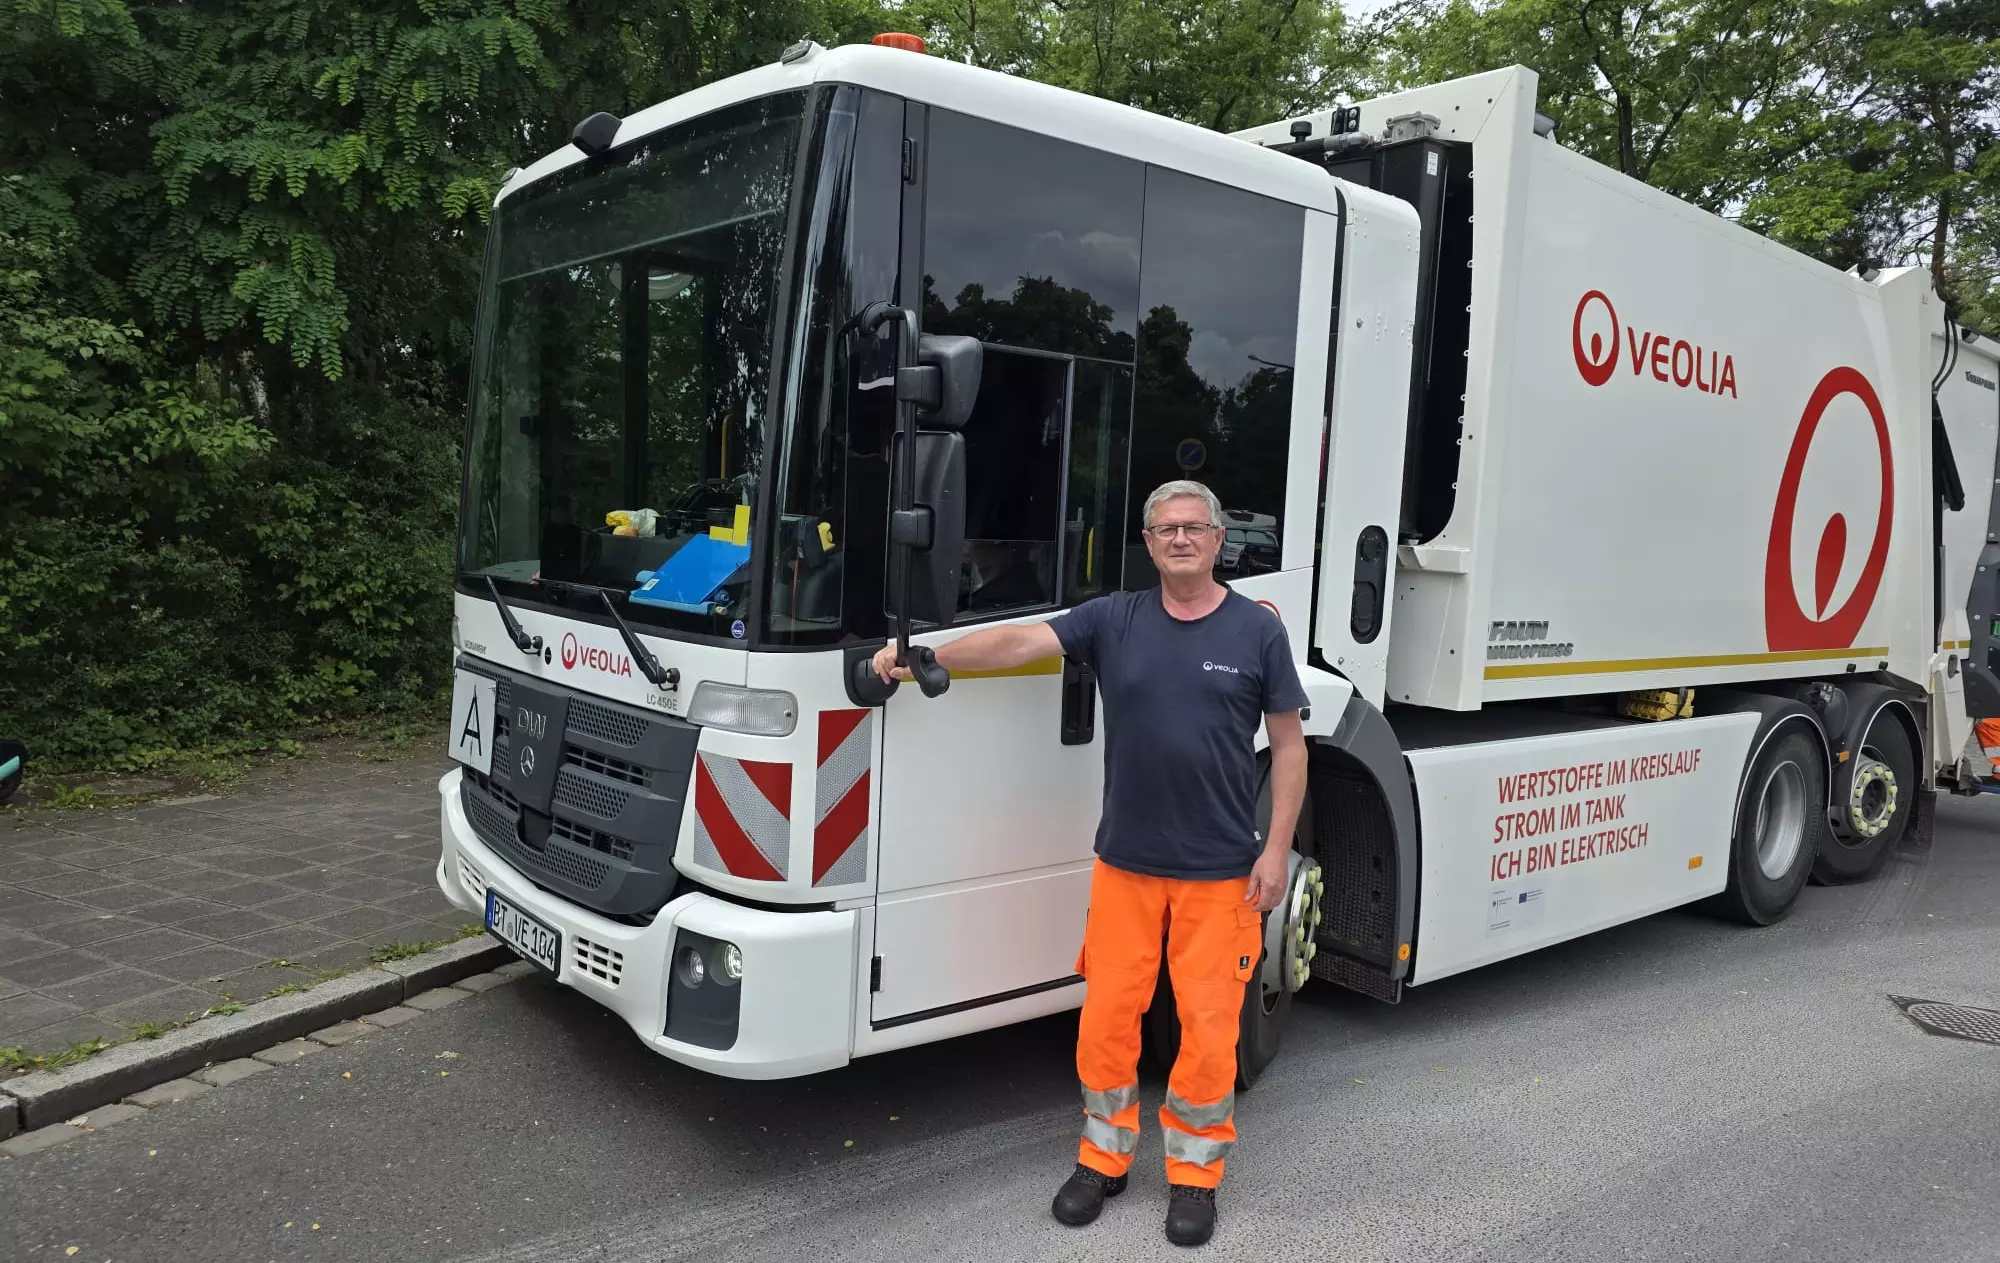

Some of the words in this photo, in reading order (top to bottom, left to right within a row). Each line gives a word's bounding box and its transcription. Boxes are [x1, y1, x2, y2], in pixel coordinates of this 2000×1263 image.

[1627, 326, 1737, 399] VEOLIA
[1488, 621, 1549, 641] FAUN
[580, 645, 632, 678] VEOLIA
[1214, 664, 1238, 673] VEOLIA
[460, 684, 482, 757] A
[1498, 763, 1604, 804] WERTSTOFFE
[1606, 760, 1626, 786] IM
[1629, 749, 1702, 783] KREISLAUF
[1493, 807, 1556, 844] STROM
[1560, 803, 1581, 830] IM
[1585, 794, 1627, 825] TANK
[1490, 849, 1522, 881] ICH
[1526, 841, 1557, 874] BIN
[1560, 823, 1649, 865] ELEKTRISCH
[494, 900, 508, 932] BT
[515, 914, 529, 949] VE
[531, 927, 554, 966] 104
